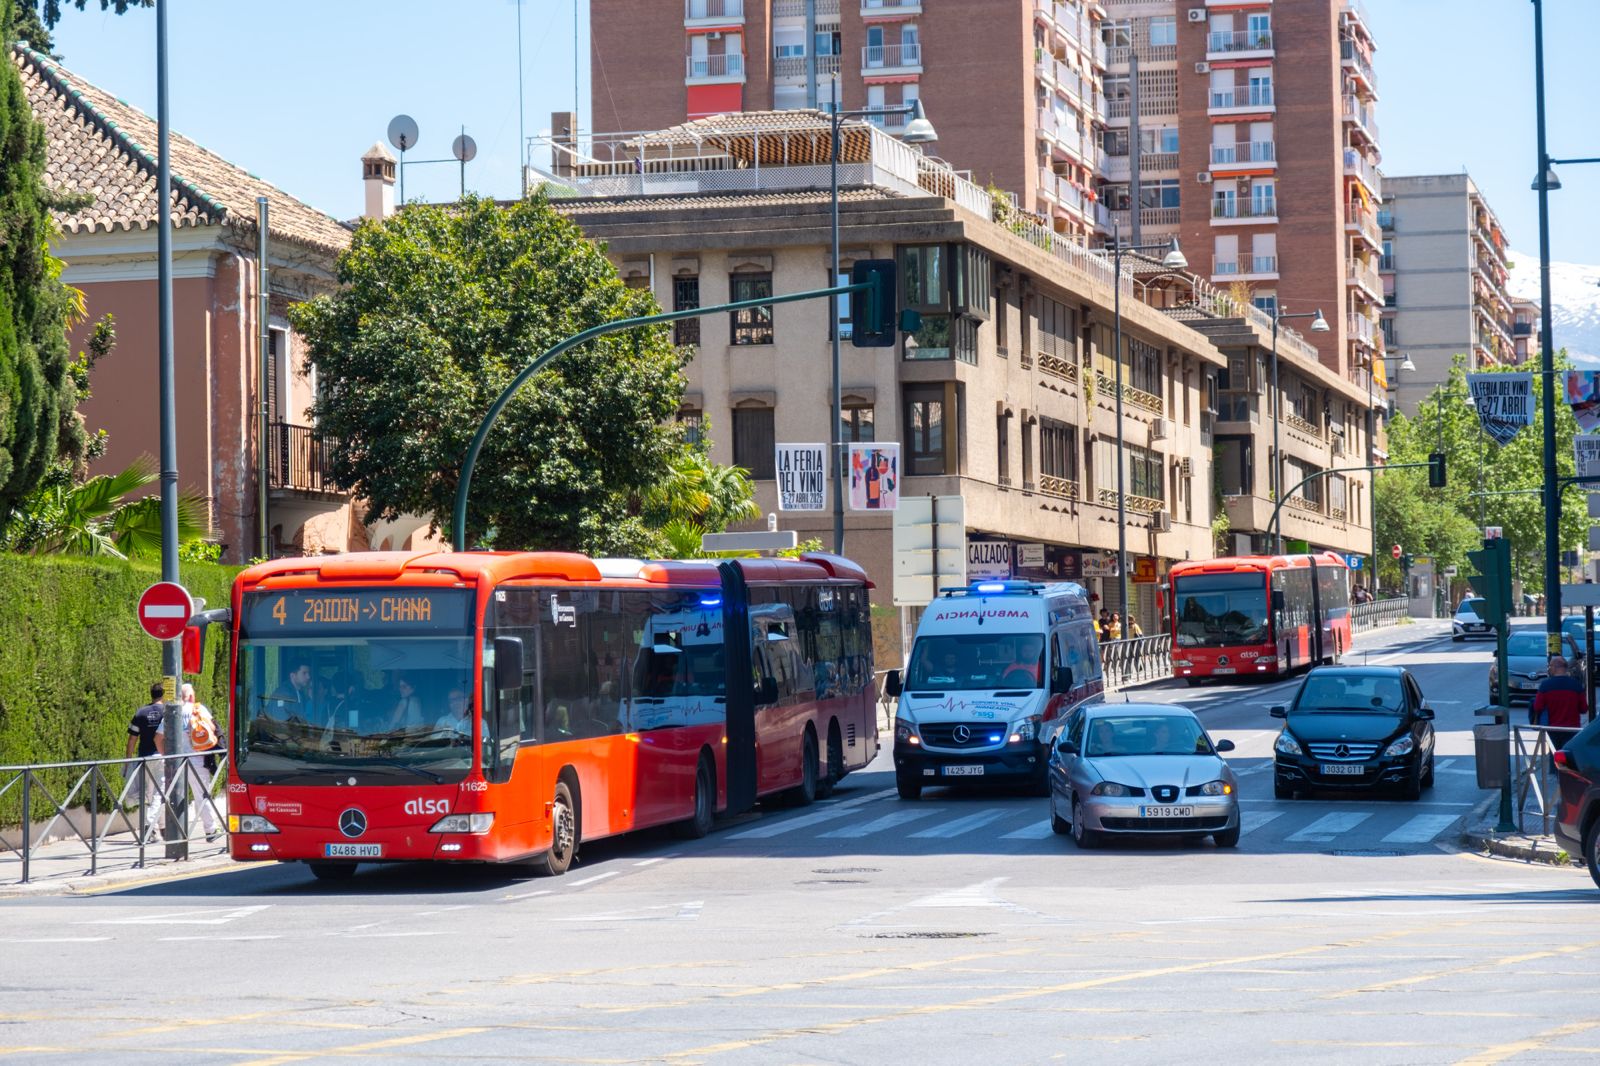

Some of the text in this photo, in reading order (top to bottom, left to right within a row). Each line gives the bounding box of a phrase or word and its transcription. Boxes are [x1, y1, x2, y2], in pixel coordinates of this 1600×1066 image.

[1479, 381, 1498, 396] FERIA
[1499, 381, 1510, 396] DEL
[1512, 380, 1528, 396] VINO
[1501, 396, 1528, 415] ABRIL
[778, 450, 823, 471] LA FERIA
[779, 471, 823, 493] DEL VINO
[968, 544, 1009, 564] CALZADO
[272, 596, 431, 625] 4 ZAIDIN CHANA
[1240, 651, 1259, 659] alsa
[946, 767, 965, 775] 1425
[1326, 765, 1345, 774] 3032
[459, 781, 488, 792] 11625
[404, 797, 449, 815] alsa
[1147, 807, 1191, 817] 5919 CMD
[331, 845, 380, 856] 3486 HVD
